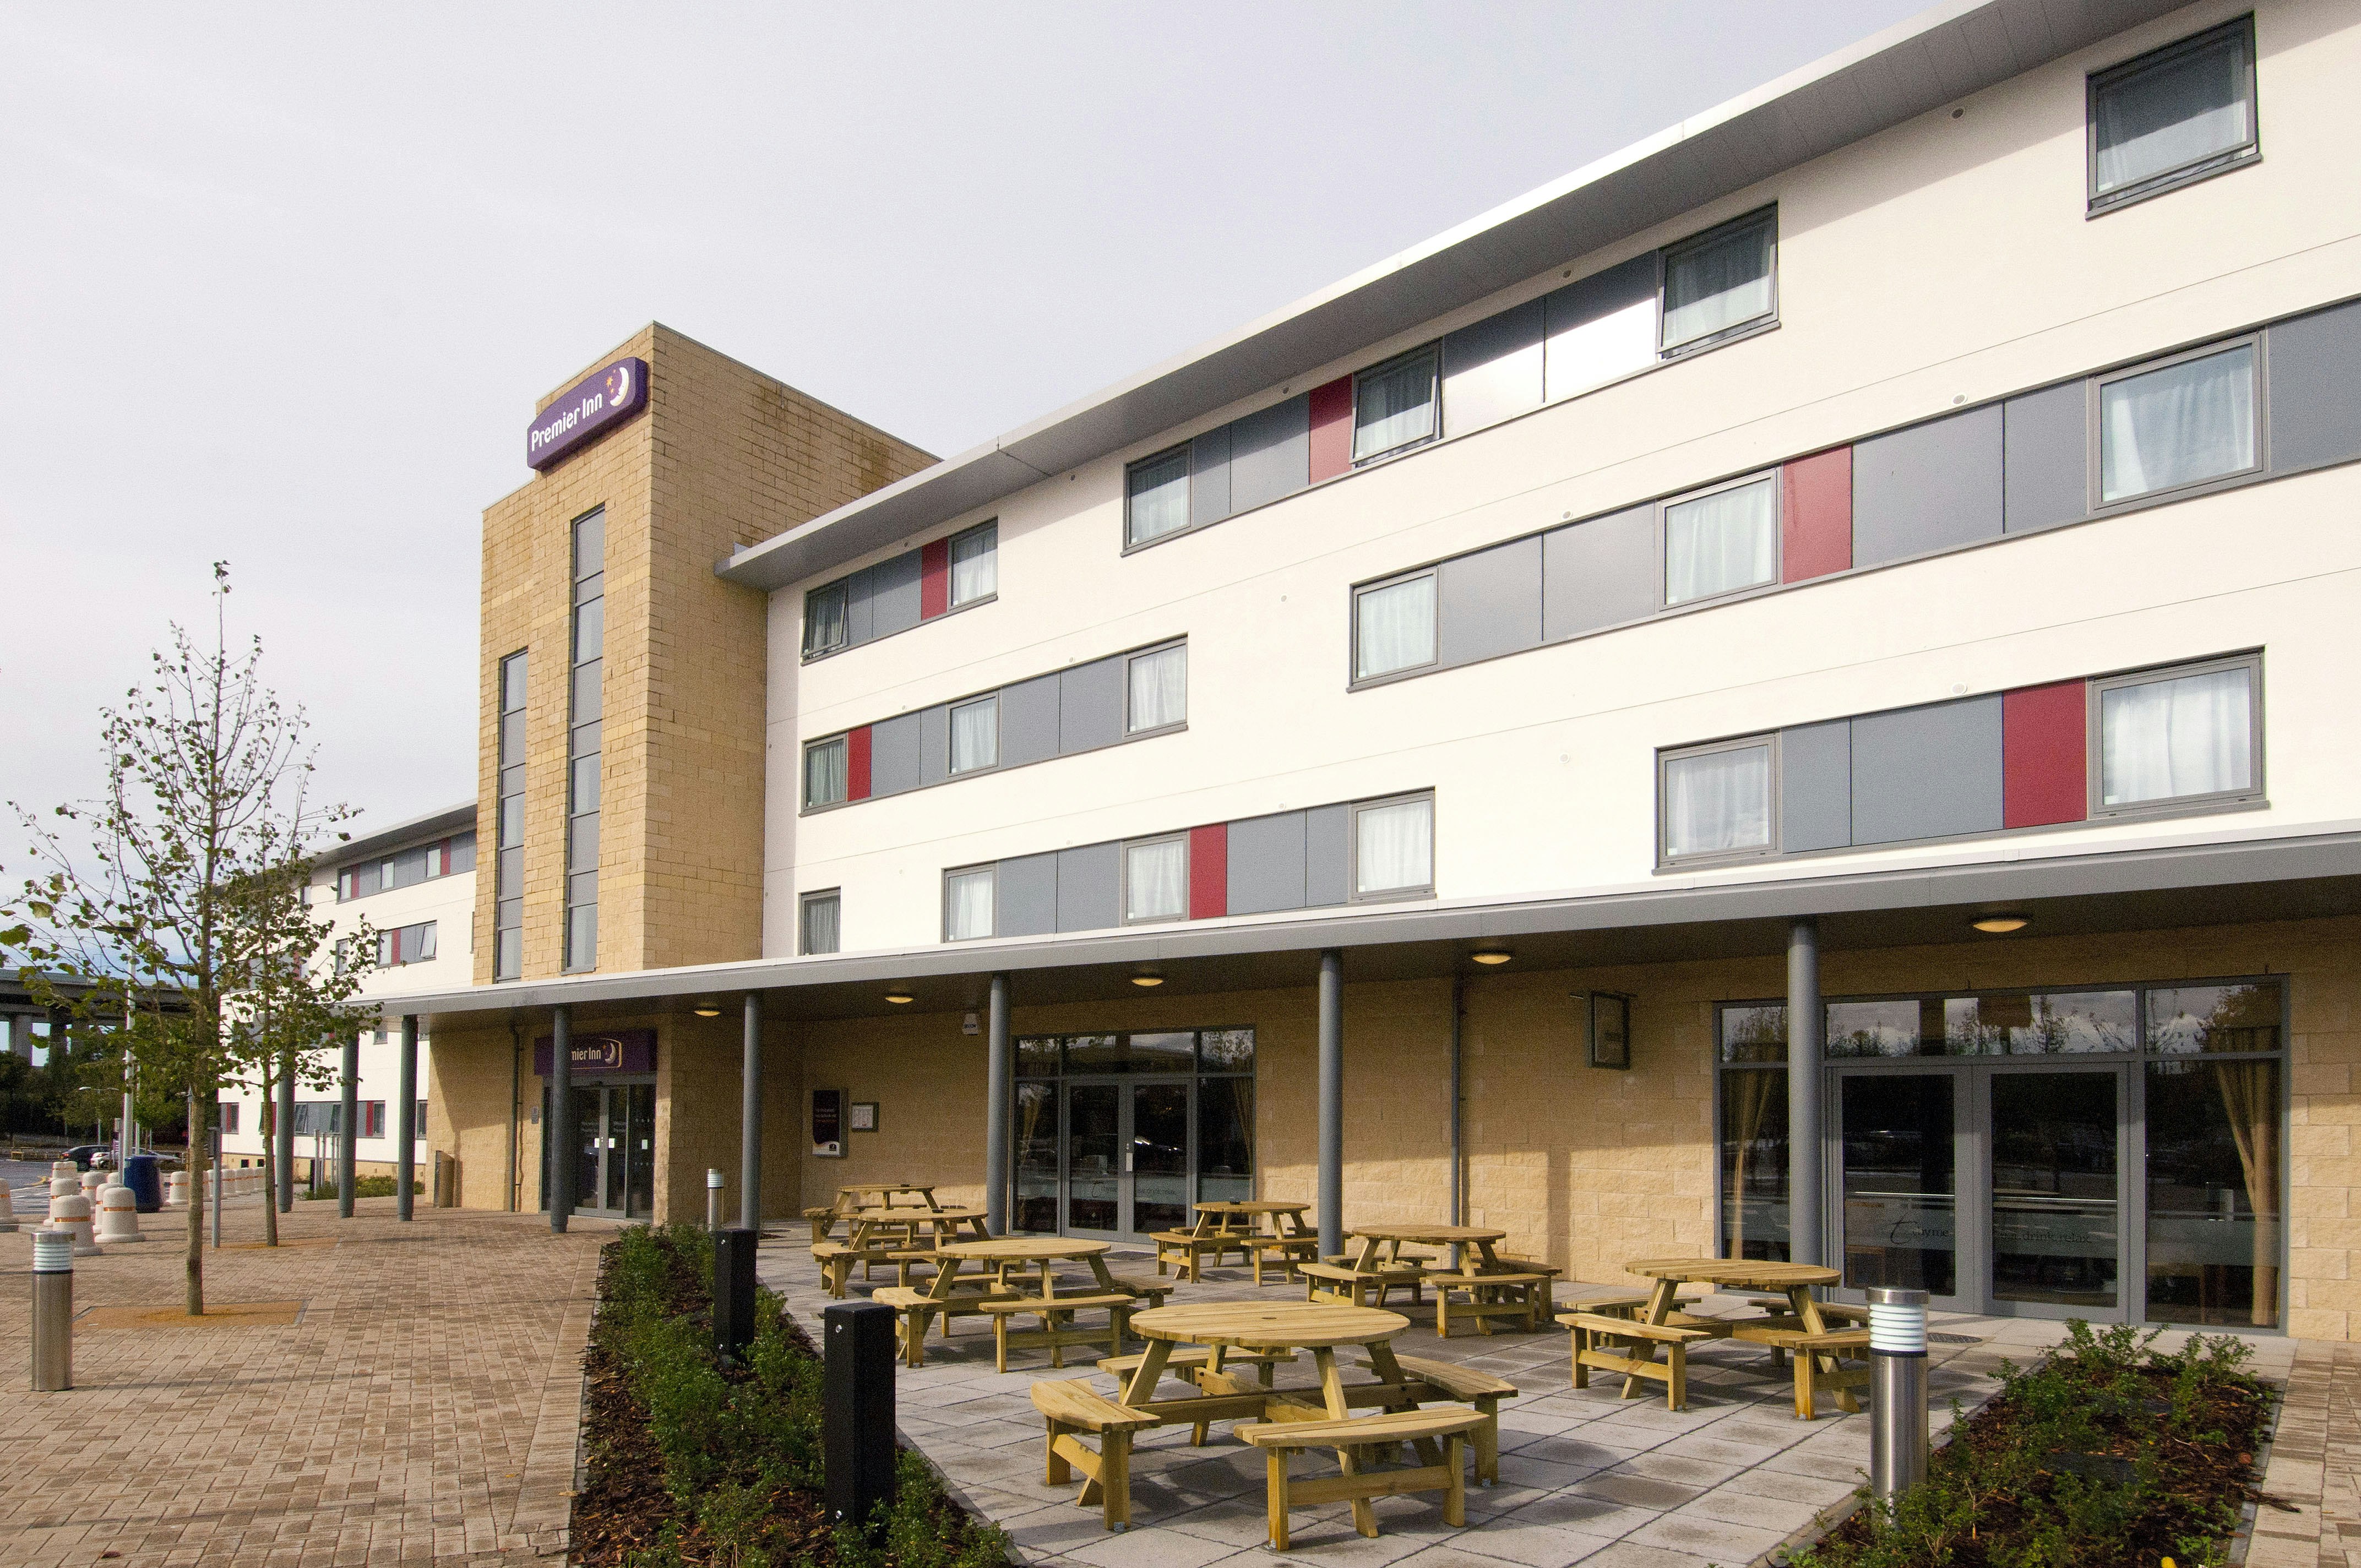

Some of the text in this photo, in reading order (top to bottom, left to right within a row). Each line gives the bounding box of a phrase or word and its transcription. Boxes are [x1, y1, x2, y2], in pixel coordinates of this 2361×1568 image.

[531, 393, 602, 451] Premier Inn
[589, 1047, 601, 1060] Inn
